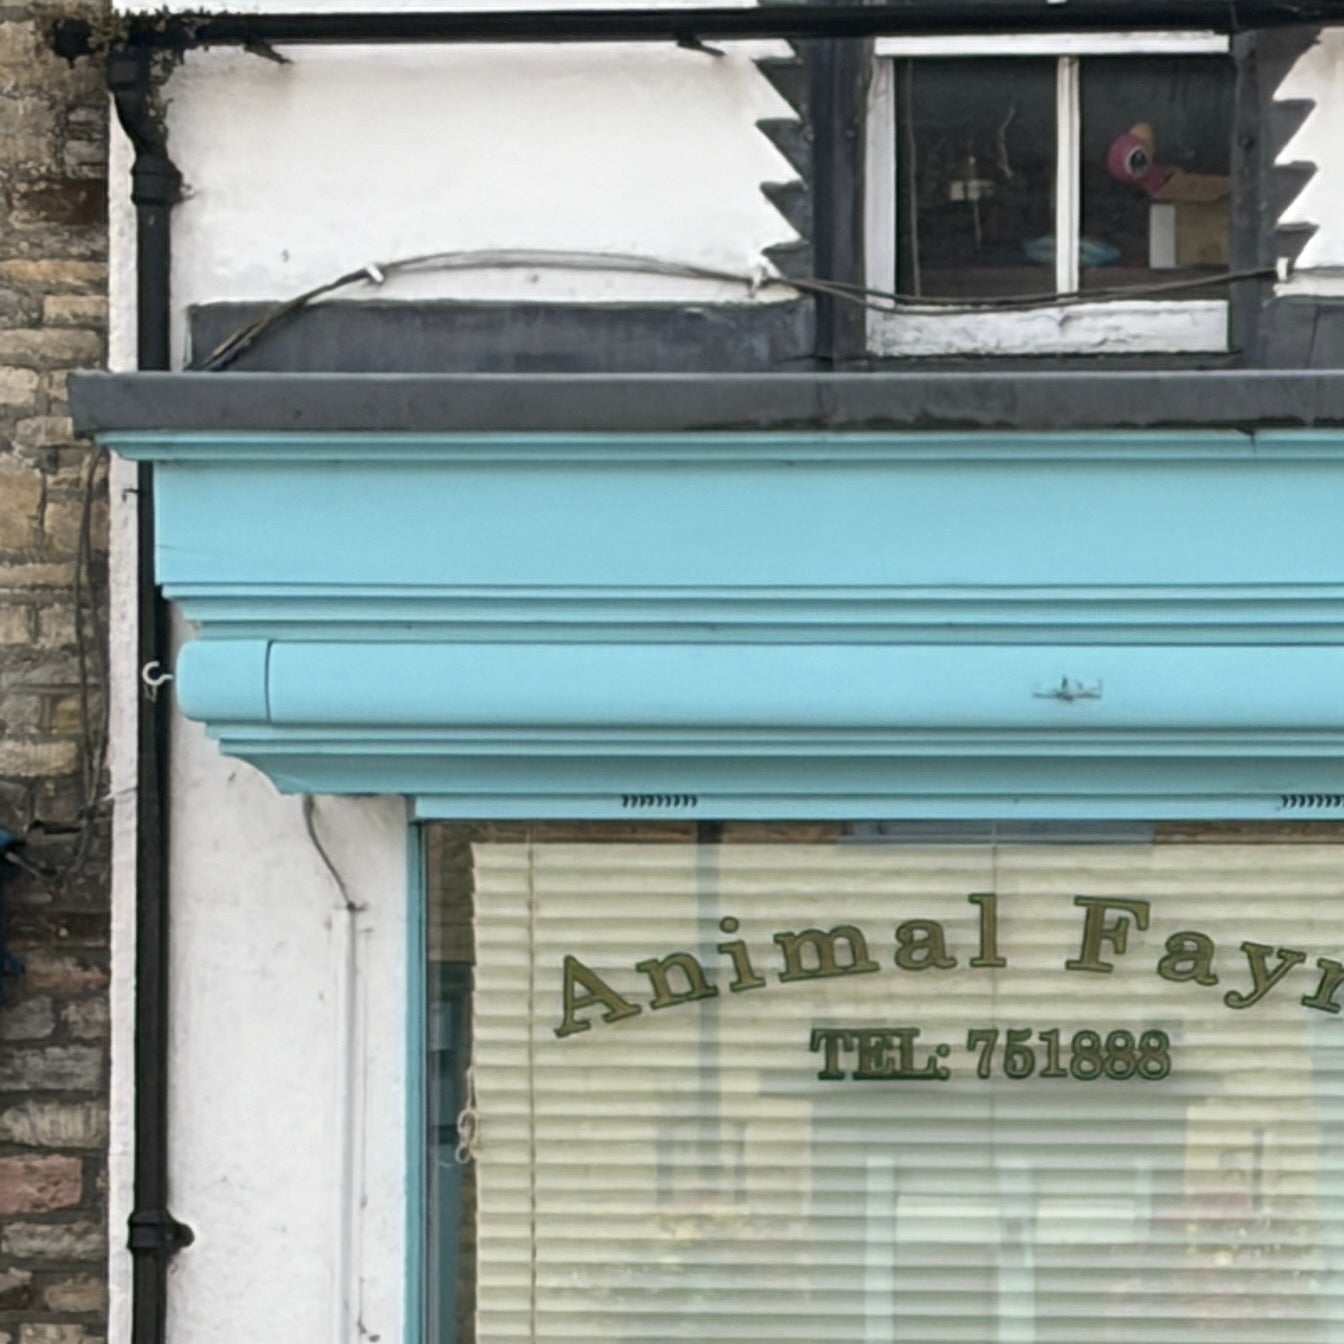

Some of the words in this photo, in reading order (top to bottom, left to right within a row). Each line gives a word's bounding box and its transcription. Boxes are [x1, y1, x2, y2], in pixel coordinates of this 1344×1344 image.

[553, 894, 1006, 1037] Animal
[810, 1028, 952, 1081] TEL:
[966, 1028, 1172, 1081] 751888
